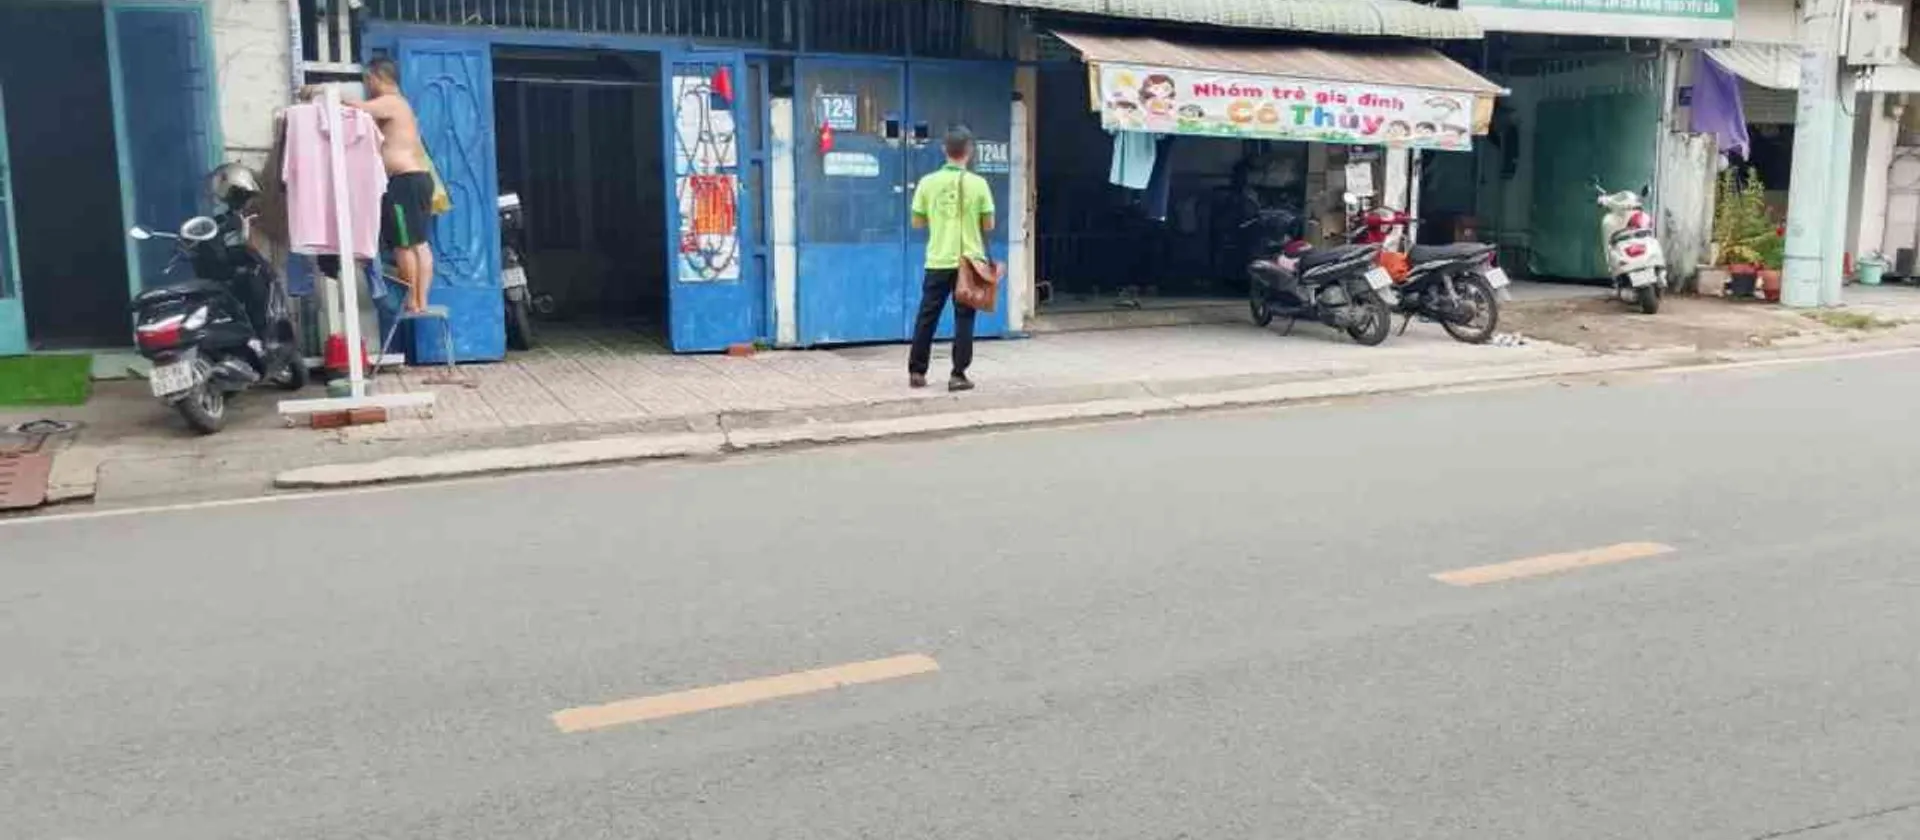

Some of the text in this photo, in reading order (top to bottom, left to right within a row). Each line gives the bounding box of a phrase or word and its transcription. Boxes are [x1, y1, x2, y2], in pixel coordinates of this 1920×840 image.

[1193, 82, 1263, 97] Nhóm
[1315, 89, 1347, 104] gia
[822, 97, 854, 118] 124
[1227, 100, 1385, 135] Cô Thủy
